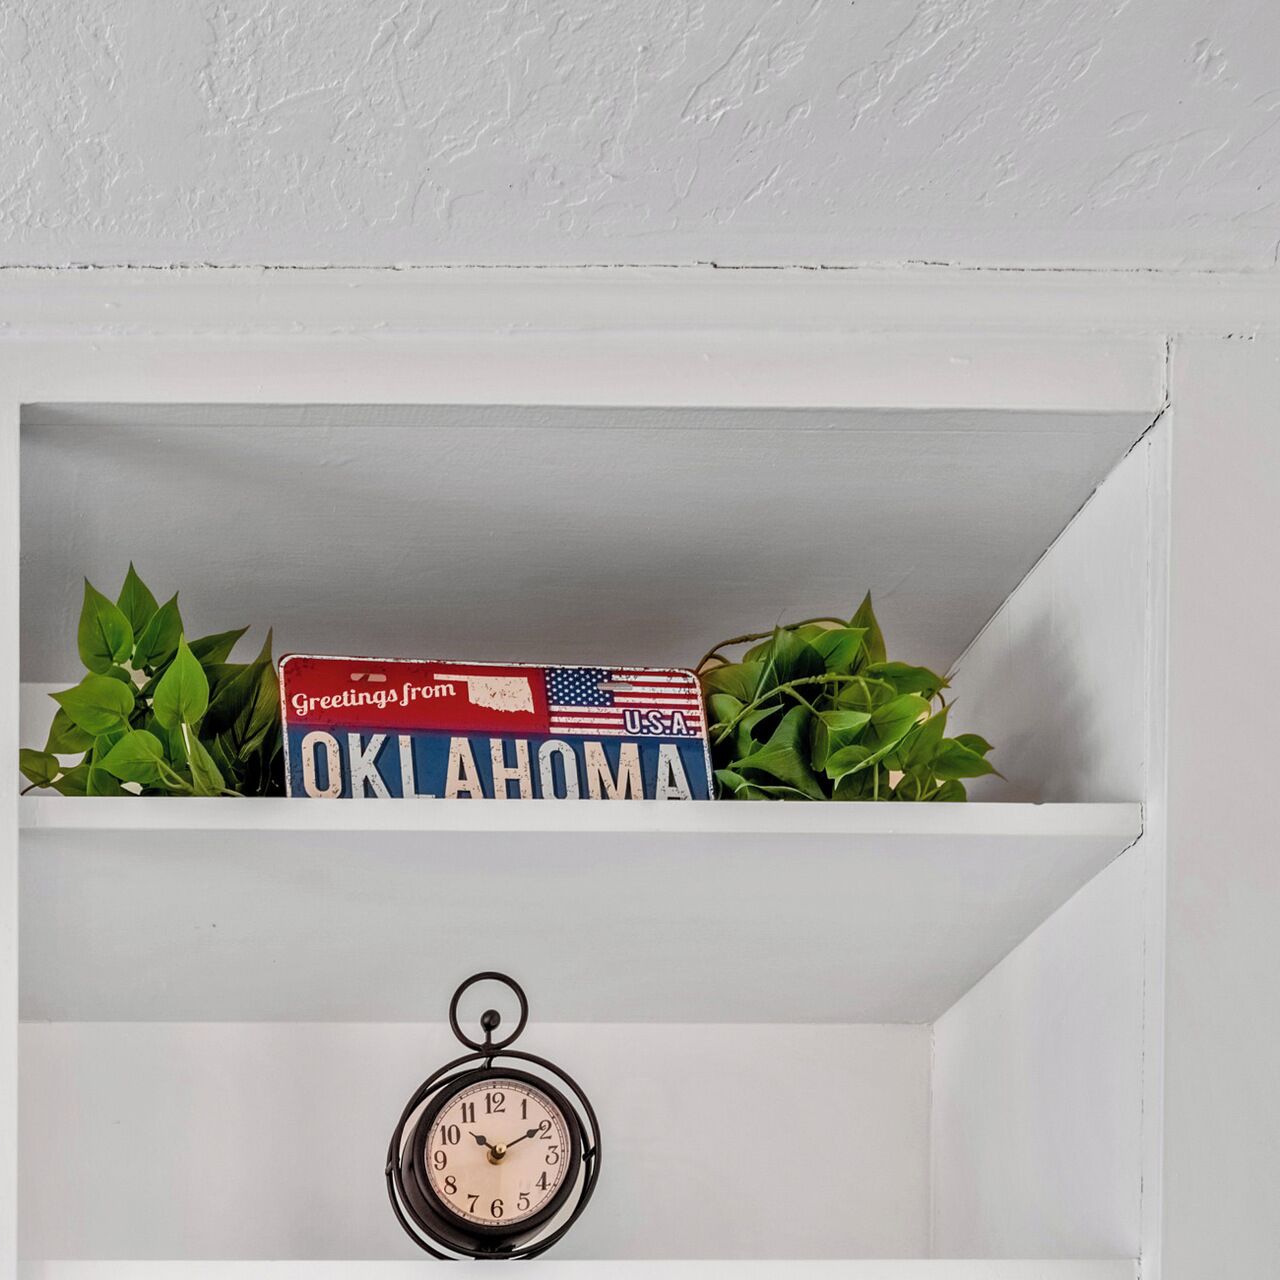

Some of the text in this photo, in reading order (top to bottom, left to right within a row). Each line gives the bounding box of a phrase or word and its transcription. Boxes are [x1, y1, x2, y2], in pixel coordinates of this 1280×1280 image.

[291, 681, 456, 717] Greetings from
[623, 709, 697, 736] U.S.A.
[300, 730, 694, 800] OKLAHOMA
[461, 1102, 476, 1124] 11
[485, 1092, 506, 1114] 12
[520, 1098, 527, 1120] 1
[440, 1124, 461, 1146] 10
[538, 1119, 552, 1140] 2
[434, 1150, 447, 1171] 9
[545, 1145, 559, 1165] 3
[443, 1175, 458, 1195] 8
[535, 1171, 551, 1191] 4
[467, 1194, 480, 1214] 7
[490, 1198, 504, 1219] 6
[517, 1192, 531, 1212] 5
